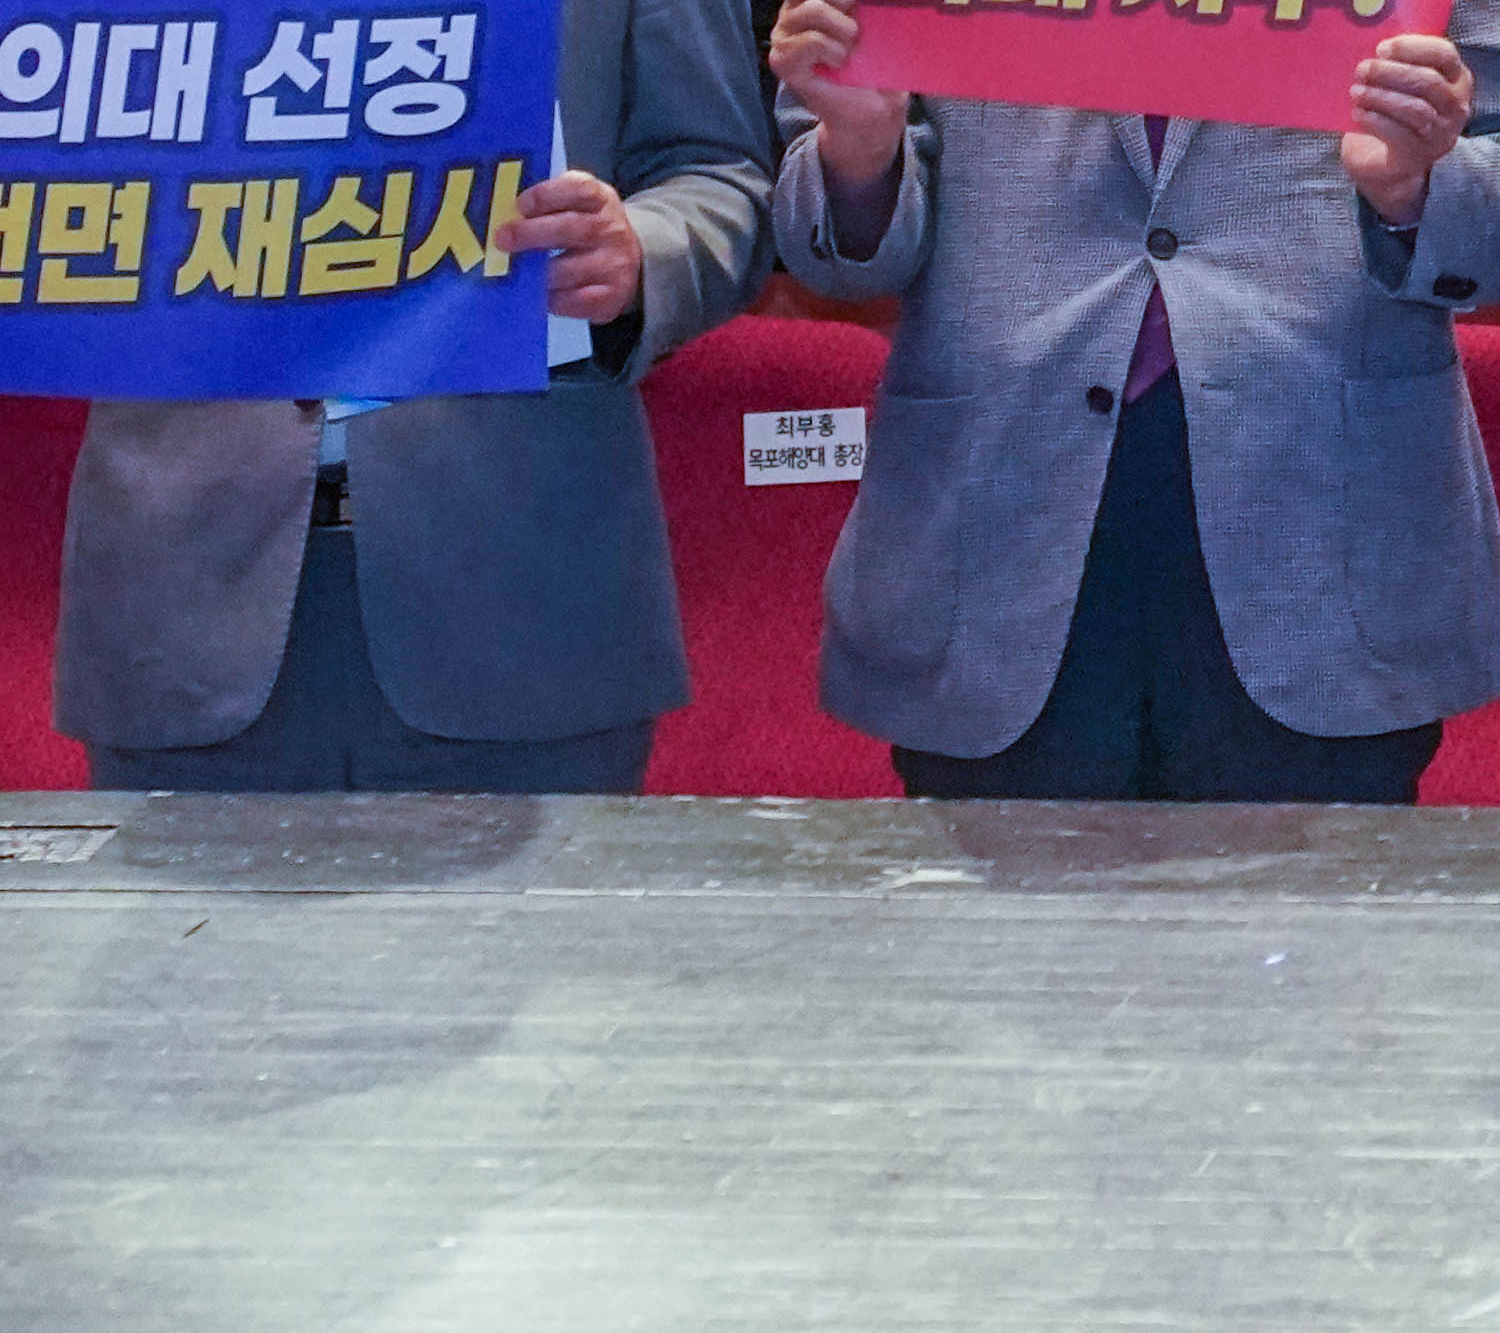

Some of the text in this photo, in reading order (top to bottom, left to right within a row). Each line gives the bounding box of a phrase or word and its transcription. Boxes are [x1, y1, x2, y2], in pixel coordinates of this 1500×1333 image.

[0, 14, 476, 142] 의대 선정
[179, 162, 520, 294] 재심사
[748, 443, 864, 472] 목포해양대 총장
